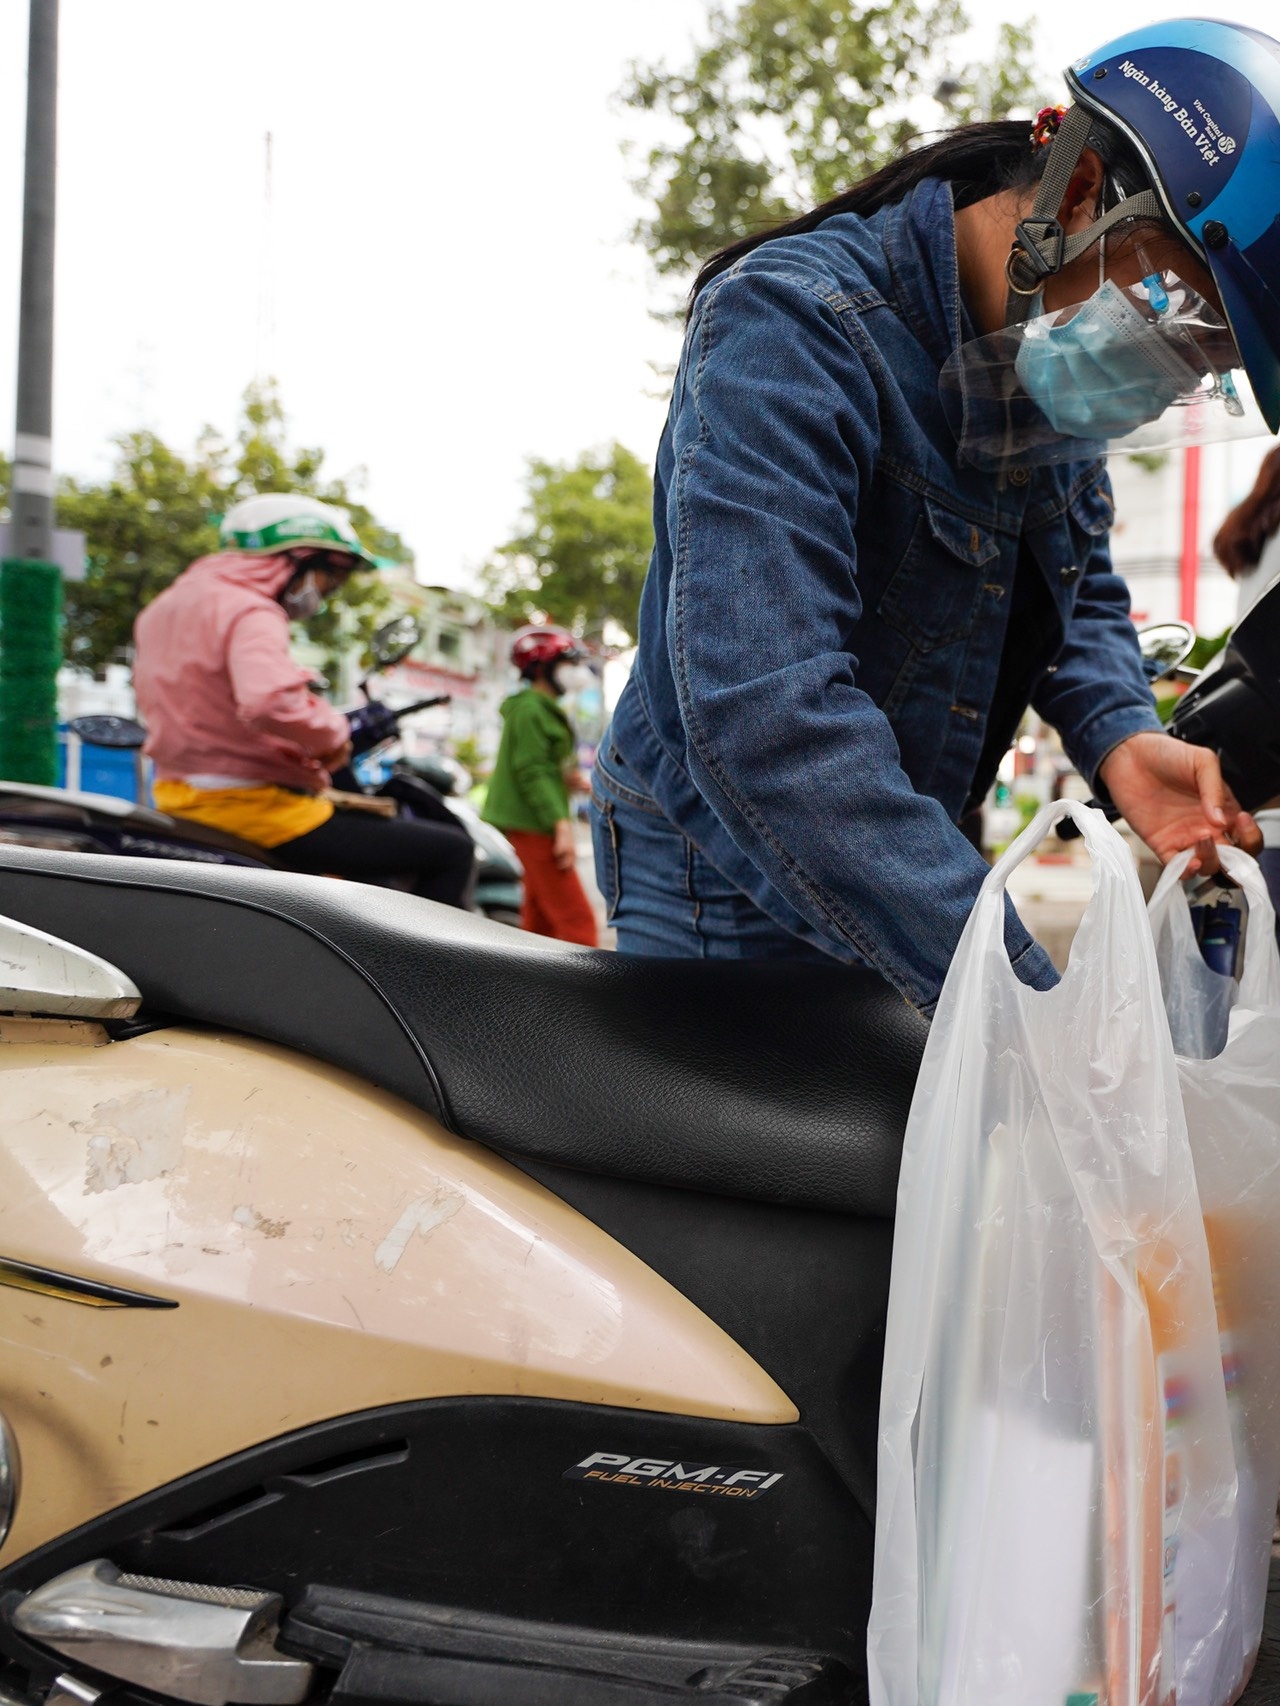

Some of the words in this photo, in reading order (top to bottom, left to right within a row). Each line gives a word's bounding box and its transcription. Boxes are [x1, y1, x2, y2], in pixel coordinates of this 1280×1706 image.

[1147, 80, 1178, 112] hàng
[1173, 108, 1198, 138] Bản
[1195, 133, 1220, 166] Việt
[1202, 112, 1224, 138] Capital
[577, 1451, 784, 1489] PGM-FI
[583, 1470, 643, 1485] FUEL
[648, 1478, 757, 1497] INJECTION
